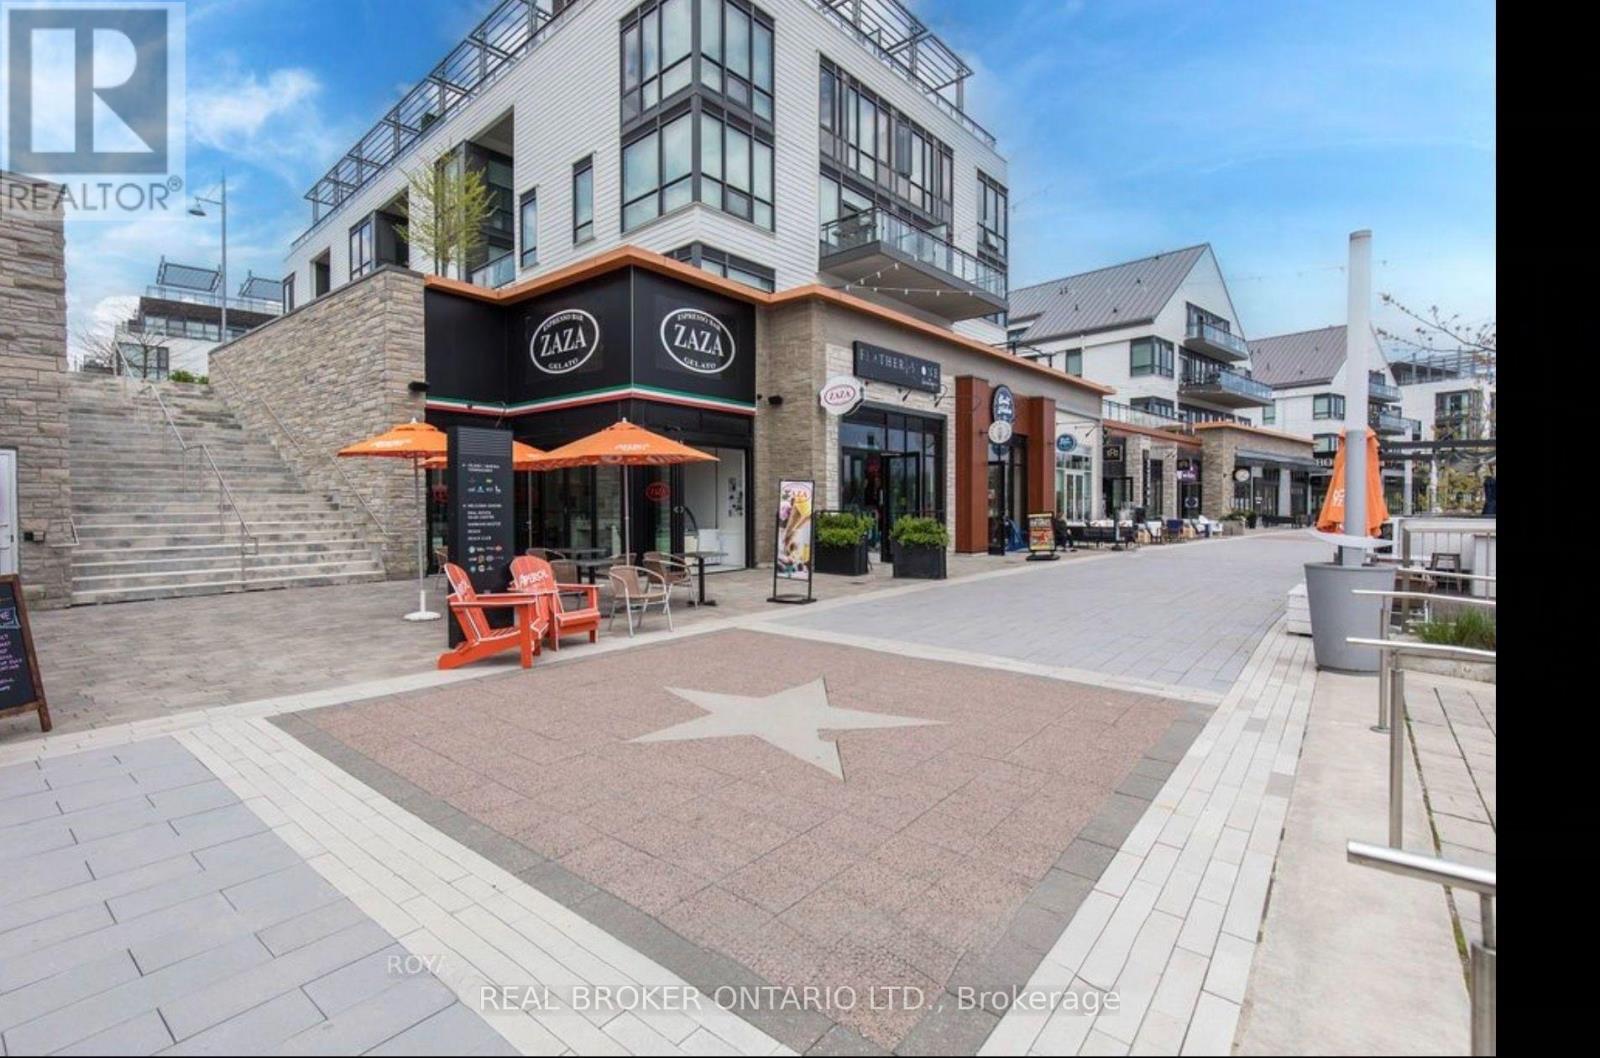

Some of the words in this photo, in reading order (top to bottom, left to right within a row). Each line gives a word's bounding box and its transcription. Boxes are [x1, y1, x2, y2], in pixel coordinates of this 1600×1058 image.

[541, 325, 587, 357] ZAZA
[674, 324, 725, 357] ZAZA
[548, 358, 578, 369] GELATO
[684, 357, 717, 369] GELATO
